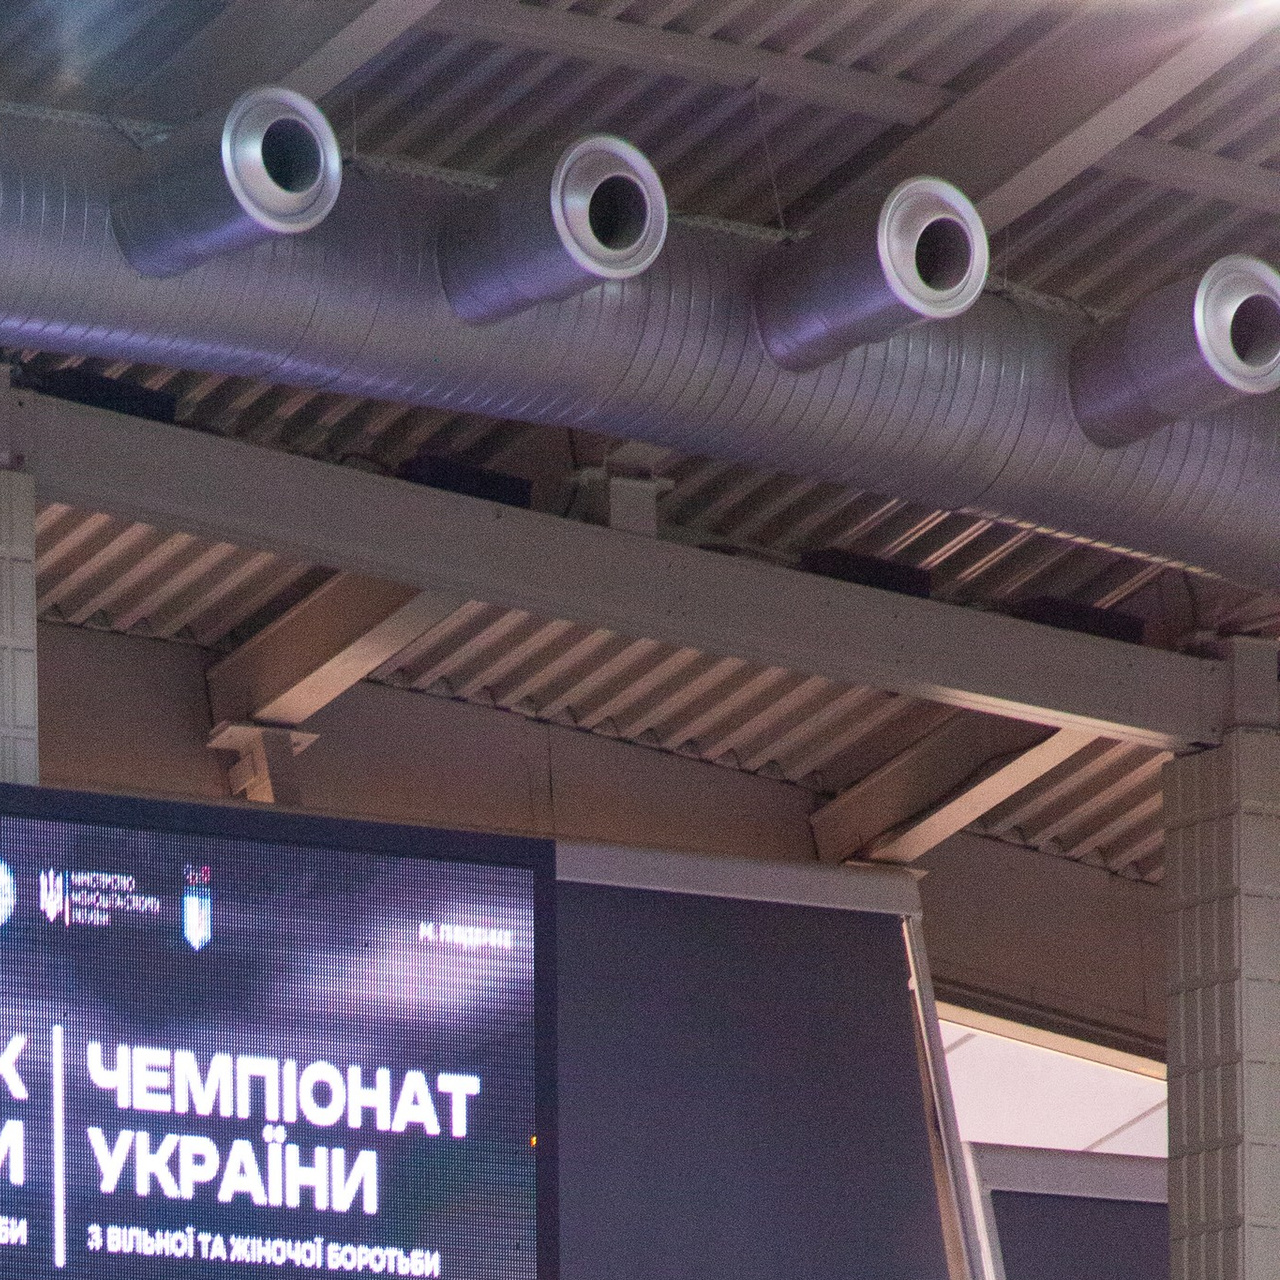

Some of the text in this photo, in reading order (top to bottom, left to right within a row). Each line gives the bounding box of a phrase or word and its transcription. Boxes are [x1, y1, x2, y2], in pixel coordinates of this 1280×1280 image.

[87, 1041, 481, 1138] ЧЕМПІОНАТ
[87, 1124, 378, 1215] УКРАЇНИ
[87, 1223, 441, 1278] З ВІЛЬНОЇ ТА ЖІНОЧОЇ БОРОТЬБИ
